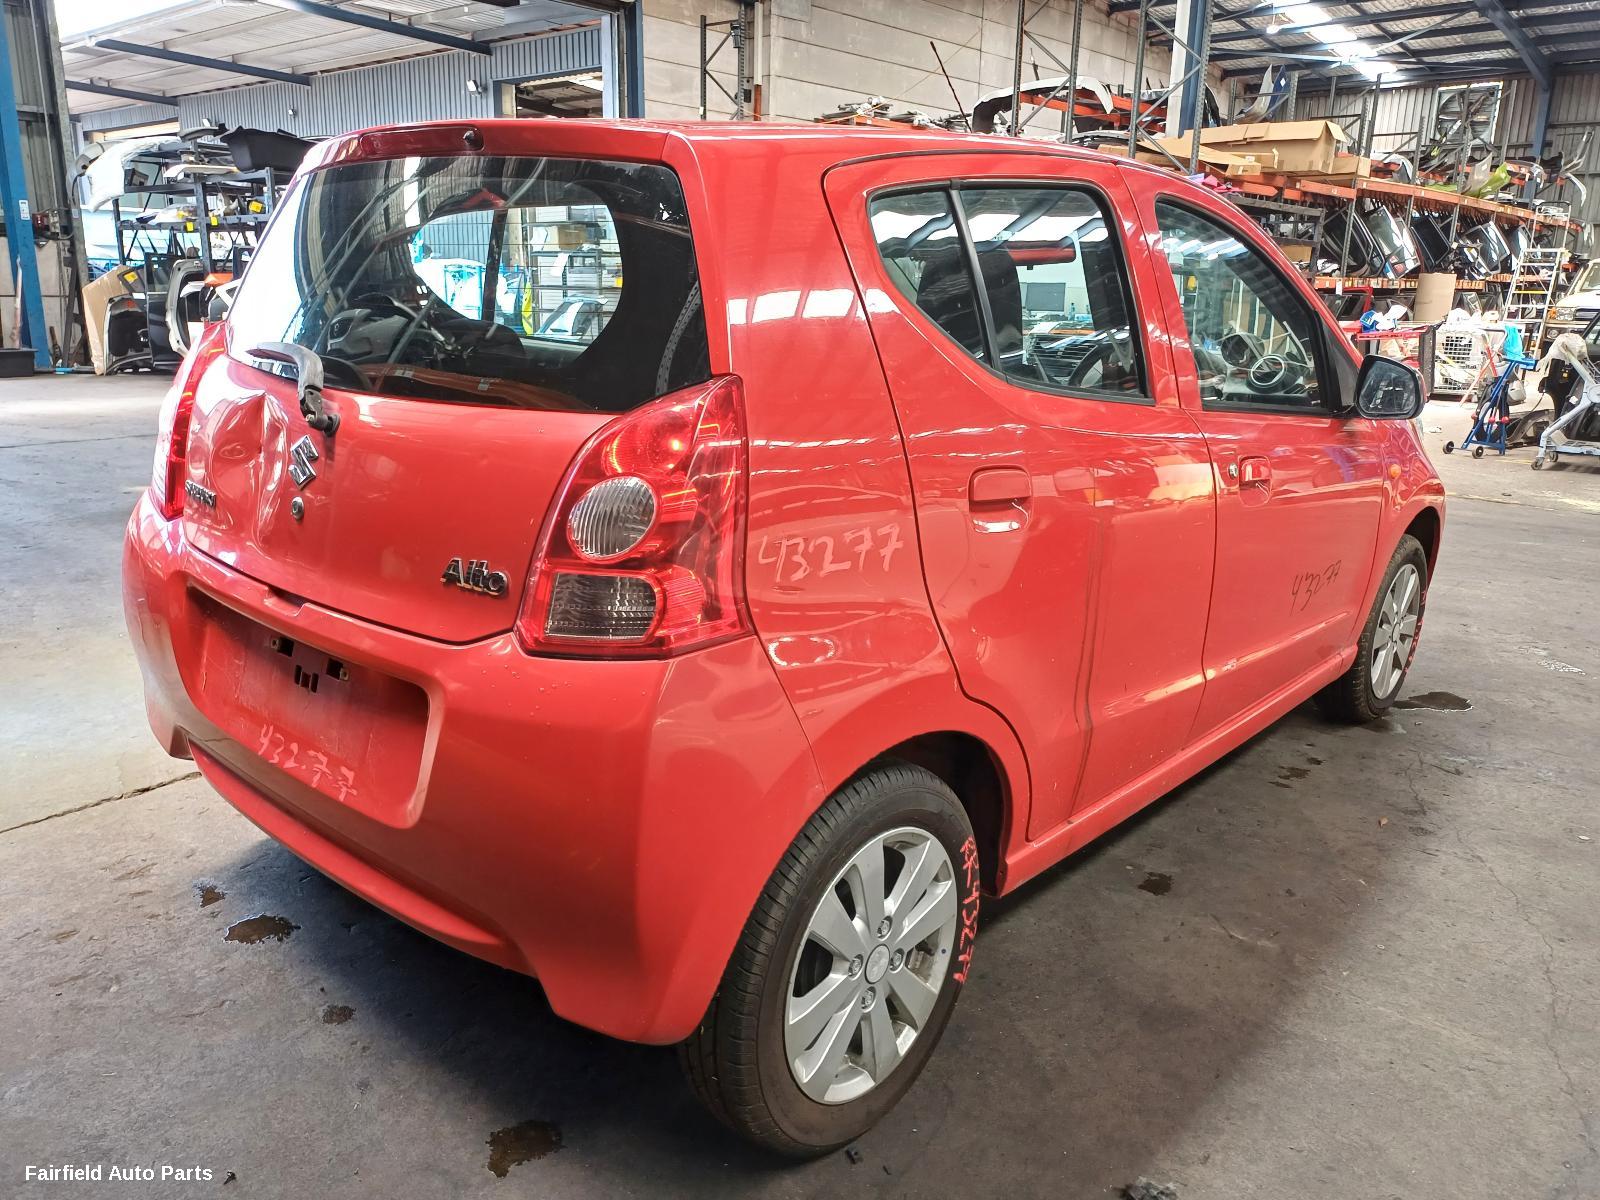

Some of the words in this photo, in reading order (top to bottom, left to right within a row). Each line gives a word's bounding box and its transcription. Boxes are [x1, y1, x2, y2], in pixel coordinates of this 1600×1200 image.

[440, 557, 508, 596] Alto
[758, 523, 904, 582] 43277
[1290, 560, 1342, 616] 43277
